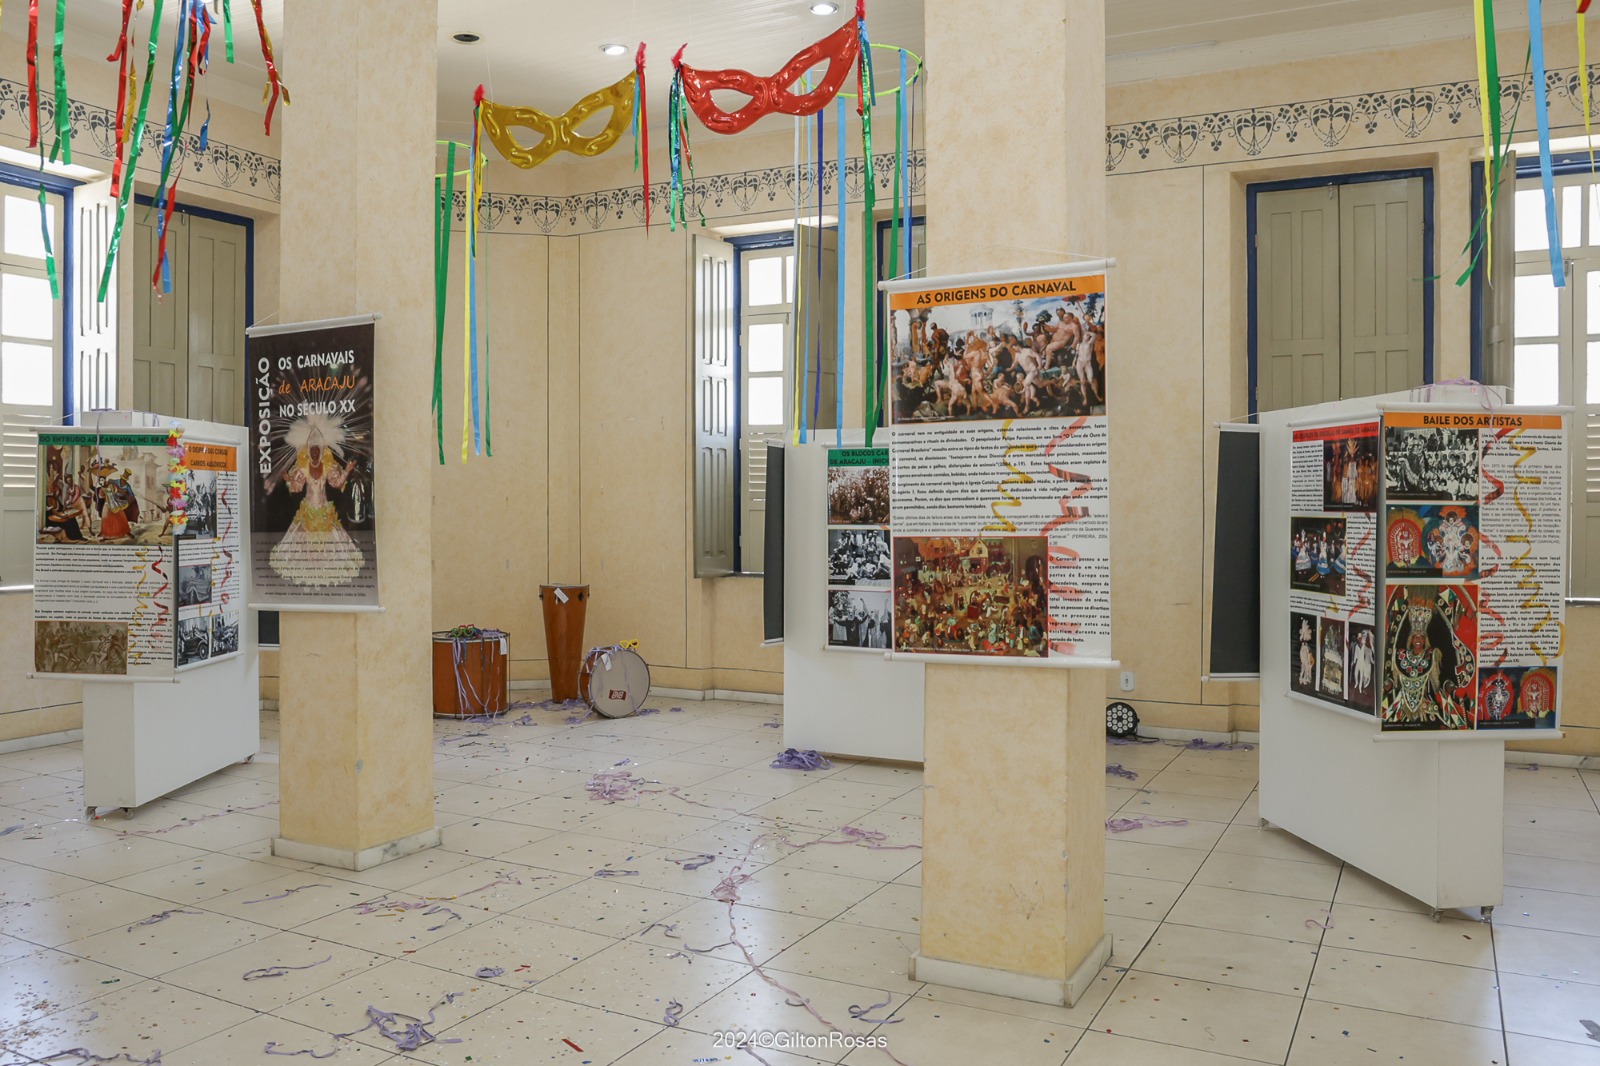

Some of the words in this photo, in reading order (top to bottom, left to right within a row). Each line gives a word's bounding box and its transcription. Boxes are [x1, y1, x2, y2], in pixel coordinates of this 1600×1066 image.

[917, 293, 931, 304] AS
[934, 288, 986, 303] ORIGENS
[990, 286, 1008, 298] DO
[1012, 280, 1076, 296] CARNAVAL
[278, 356, 292, 370] OS
[297, 350, 354, 368] CARNAVAIS
[278, 380, 290, 394] de
[300, 375, 356, 392] ARACAJU
[256, 358, 272, 474] EXPOSIÇÃO
[280, 404, 294, 417] NO
[297, 399, 336, 416] SÉCULO
[340, 399, 356, 412] XX
[1423, 416, 1450, 425] BAILE
[1453, 416, 1474, 425] DOS
[1476, 416, 1522, 426] ARTISTAS
